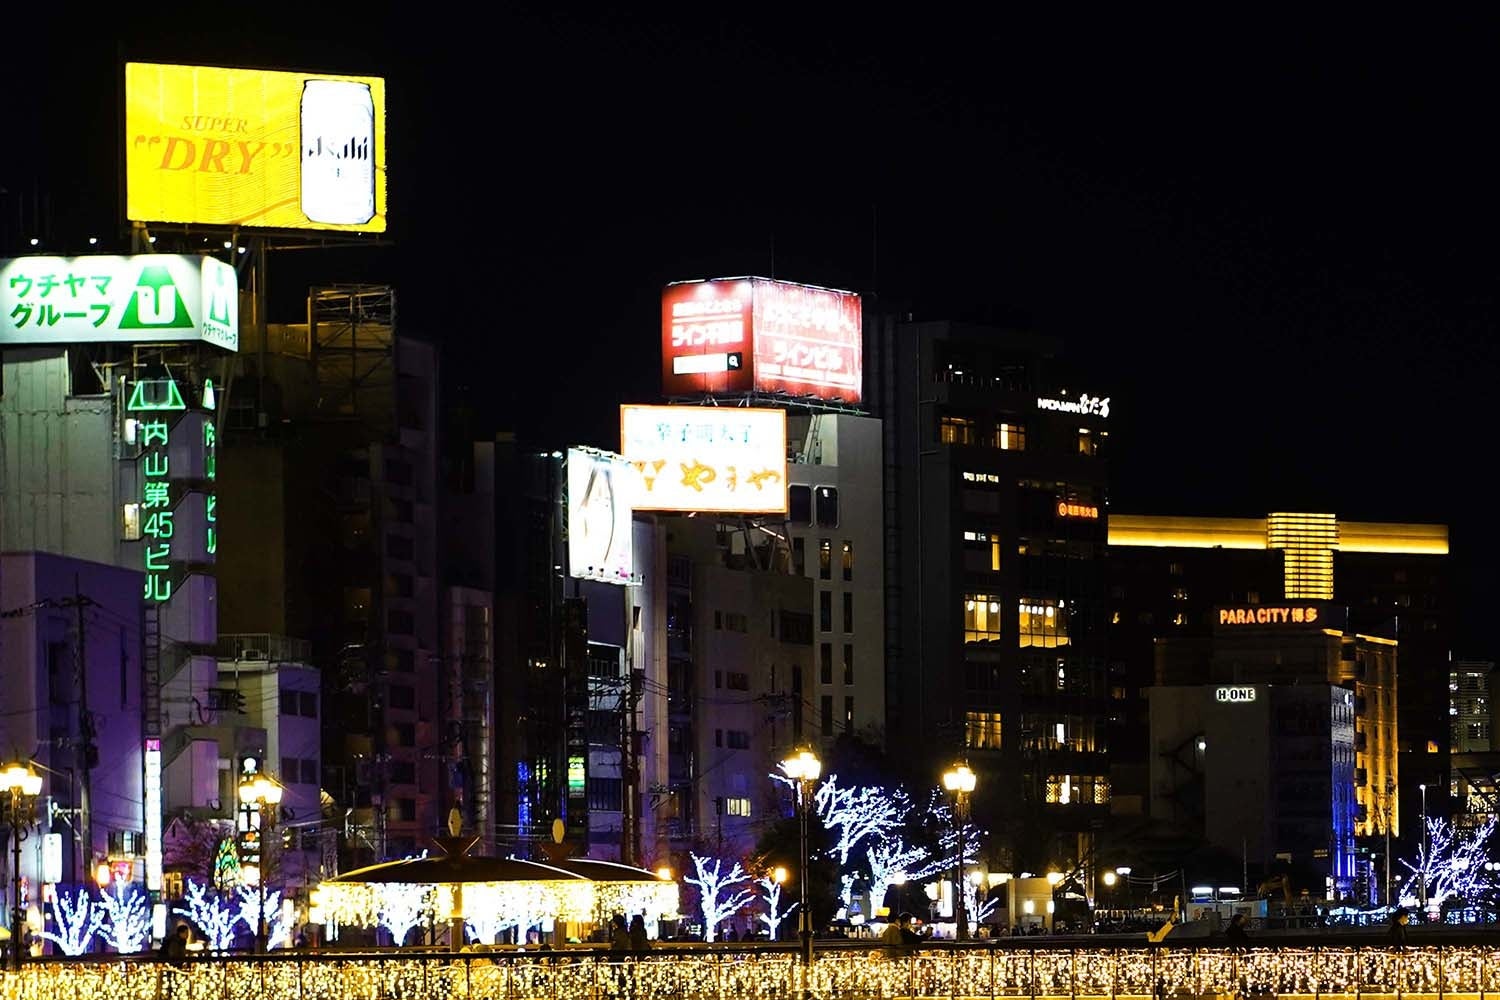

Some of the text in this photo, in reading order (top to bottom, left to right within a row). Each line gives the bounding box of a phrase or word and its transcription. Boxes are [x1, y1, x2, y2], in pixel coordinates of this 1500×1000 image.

[181, 115, 249, 134] SUPER
[308, 135, 369, 161] Asahi
[9, 273, 113, 299] ウチヤマ
[9, 302, 115, 329] グループ
[142, 419, 174, 601] 内山第45ビル
[1257, 608, 1290, 624] CITY
